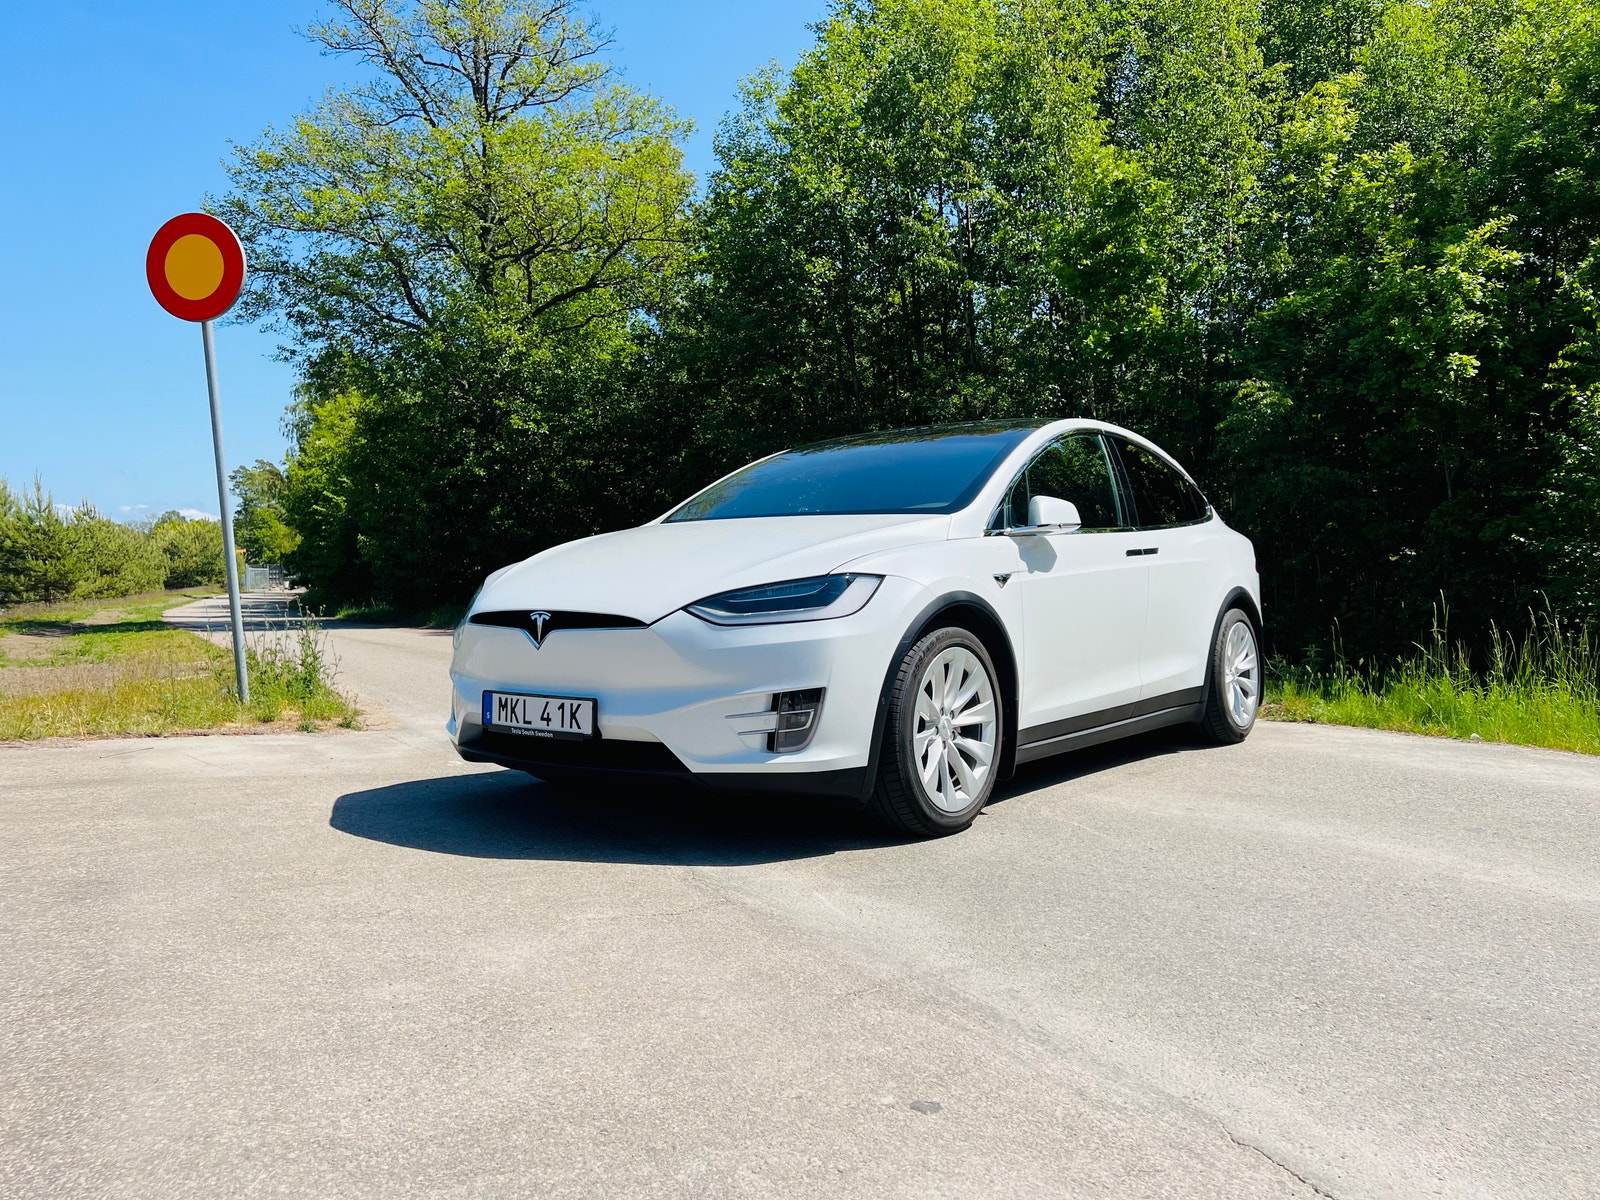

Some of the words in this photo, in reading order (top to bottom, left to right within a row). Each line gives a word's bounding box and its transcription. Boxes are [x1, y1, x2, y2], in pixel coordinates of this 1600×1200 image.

[498, 696, 533, 725] MKL
[540, 701, 582, 730] 41K
[511, 727, 521, 735] Tesla
[535, 730, 554, 738] Sweden
